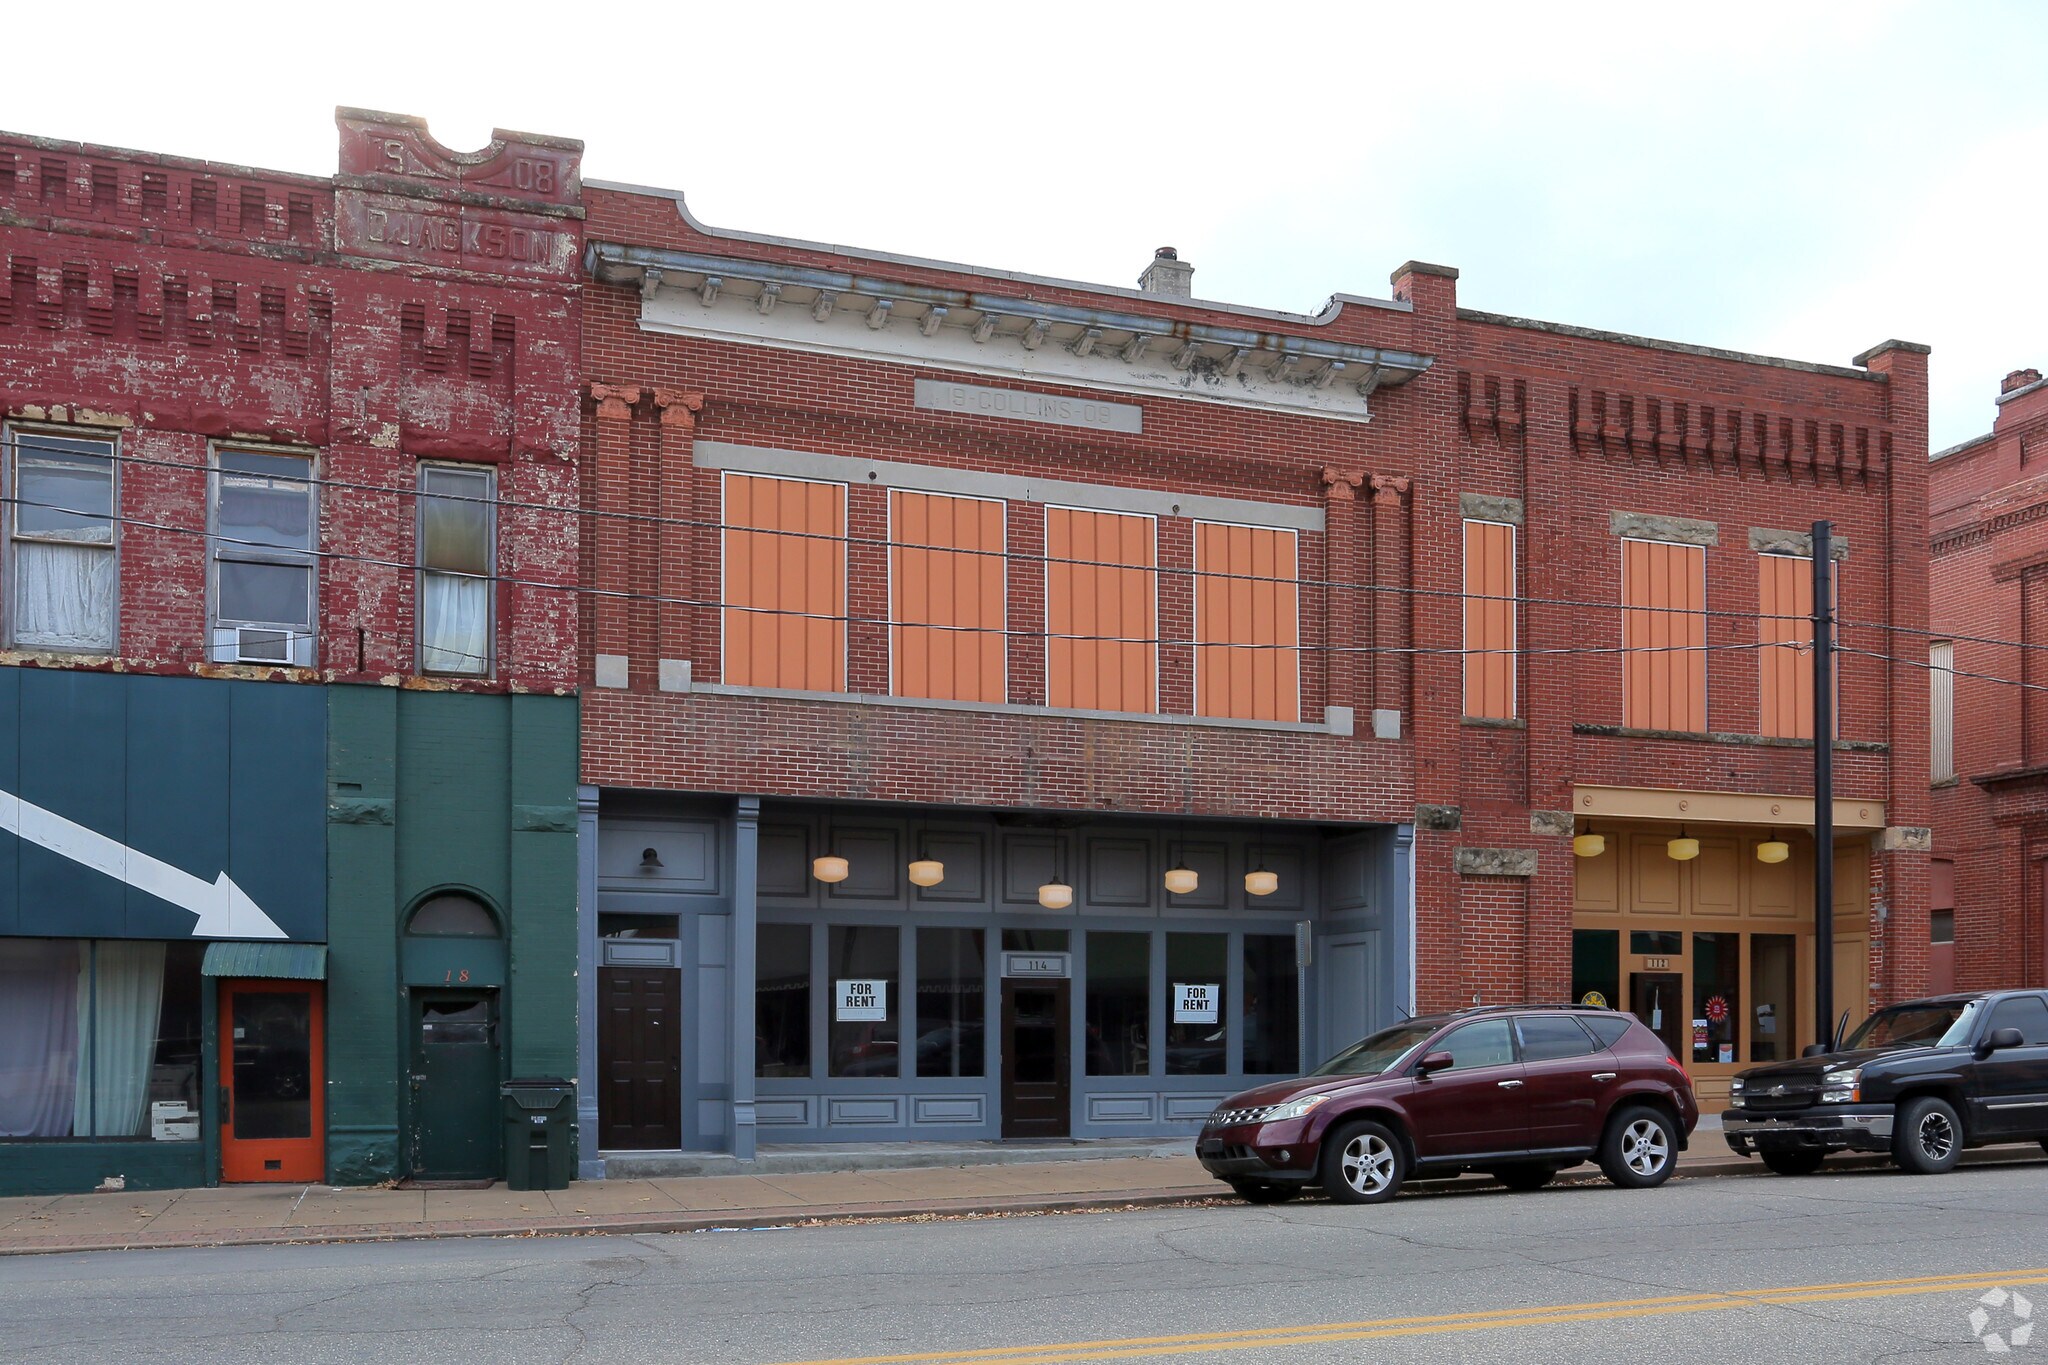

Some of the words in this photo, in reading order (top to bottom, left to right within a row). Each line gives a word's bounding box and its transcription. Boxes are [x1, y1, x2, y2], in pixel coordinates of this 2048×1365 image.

[516, 159, 552, 193] 08
[1029, 960, 1047, 970] 114
[850, 983, 872, 995] FOR
[1187, 988, 1206, 998] FOR
[846, 996, 876, 1007] RENT
[1183, 1000, 1210, 1010] RENT
